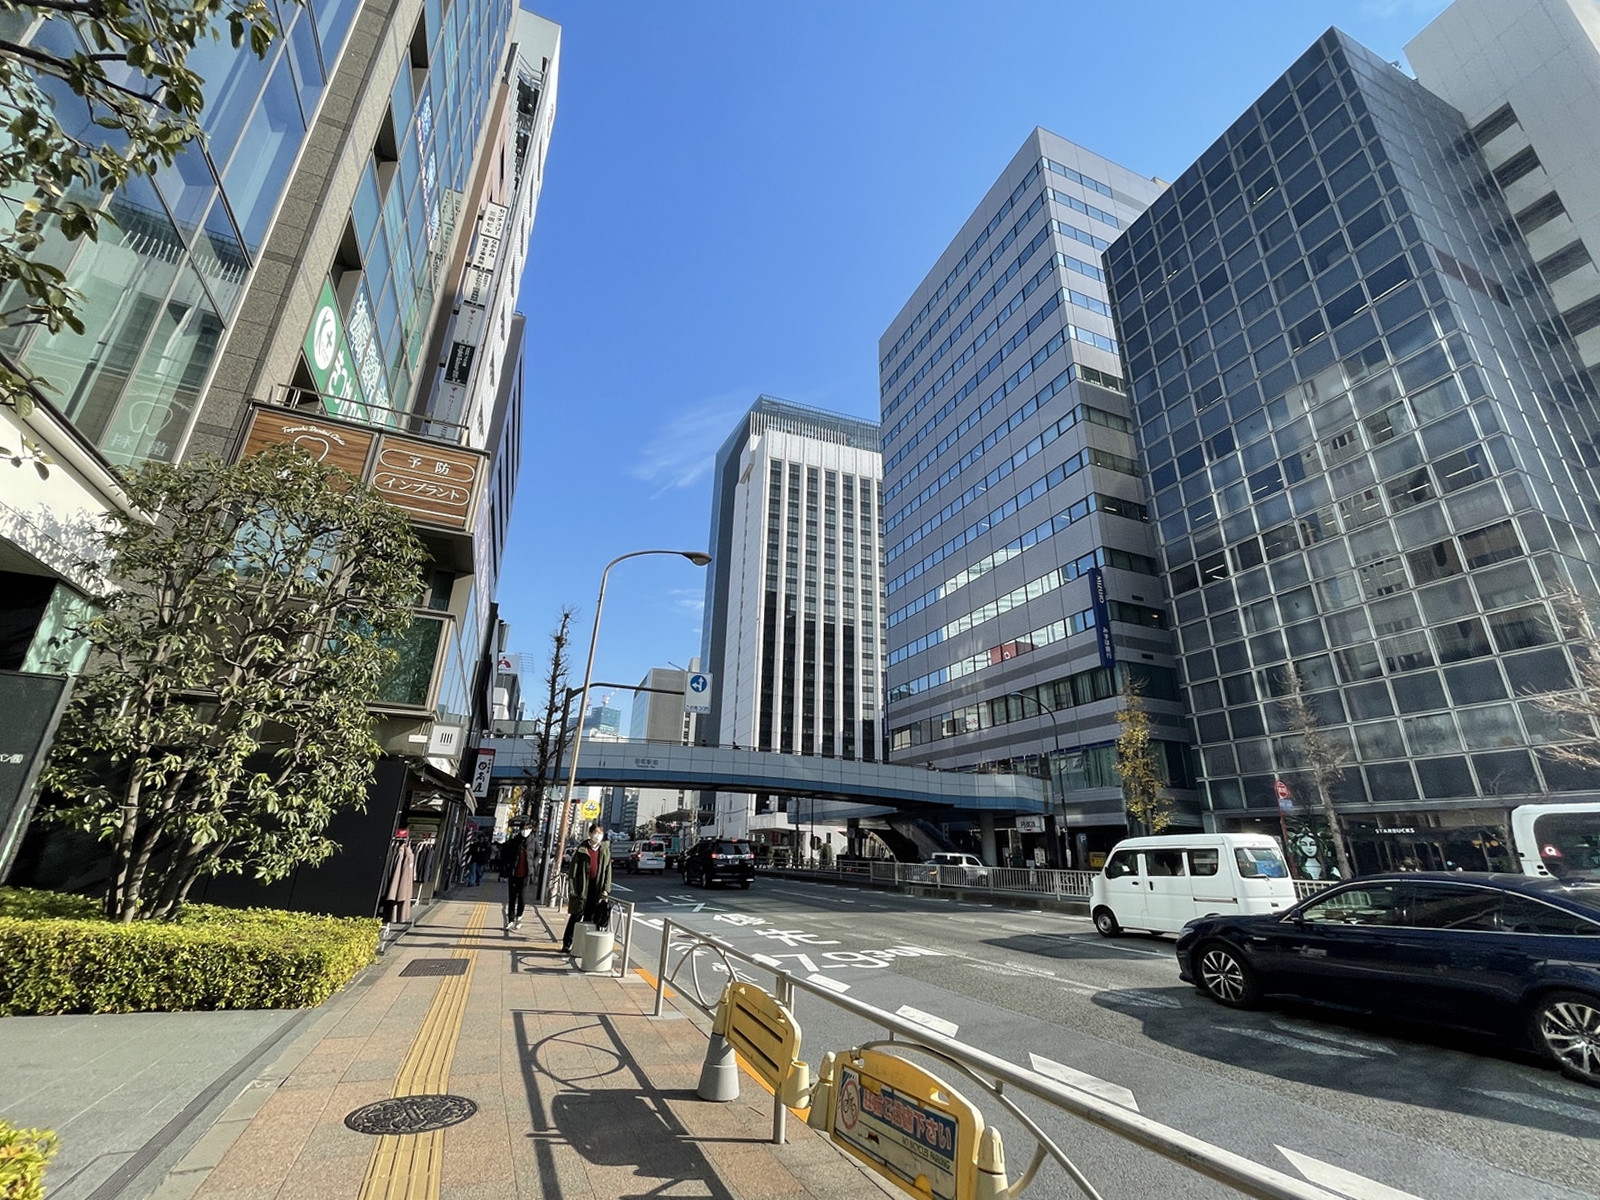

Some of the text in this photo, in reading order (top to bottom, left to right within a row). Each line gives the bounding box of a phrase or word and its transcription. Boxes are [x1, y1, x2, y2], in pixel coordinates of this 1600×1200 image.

[408, 456, 451, 475] 予防
[383, 477, 460, 500] インプラント
